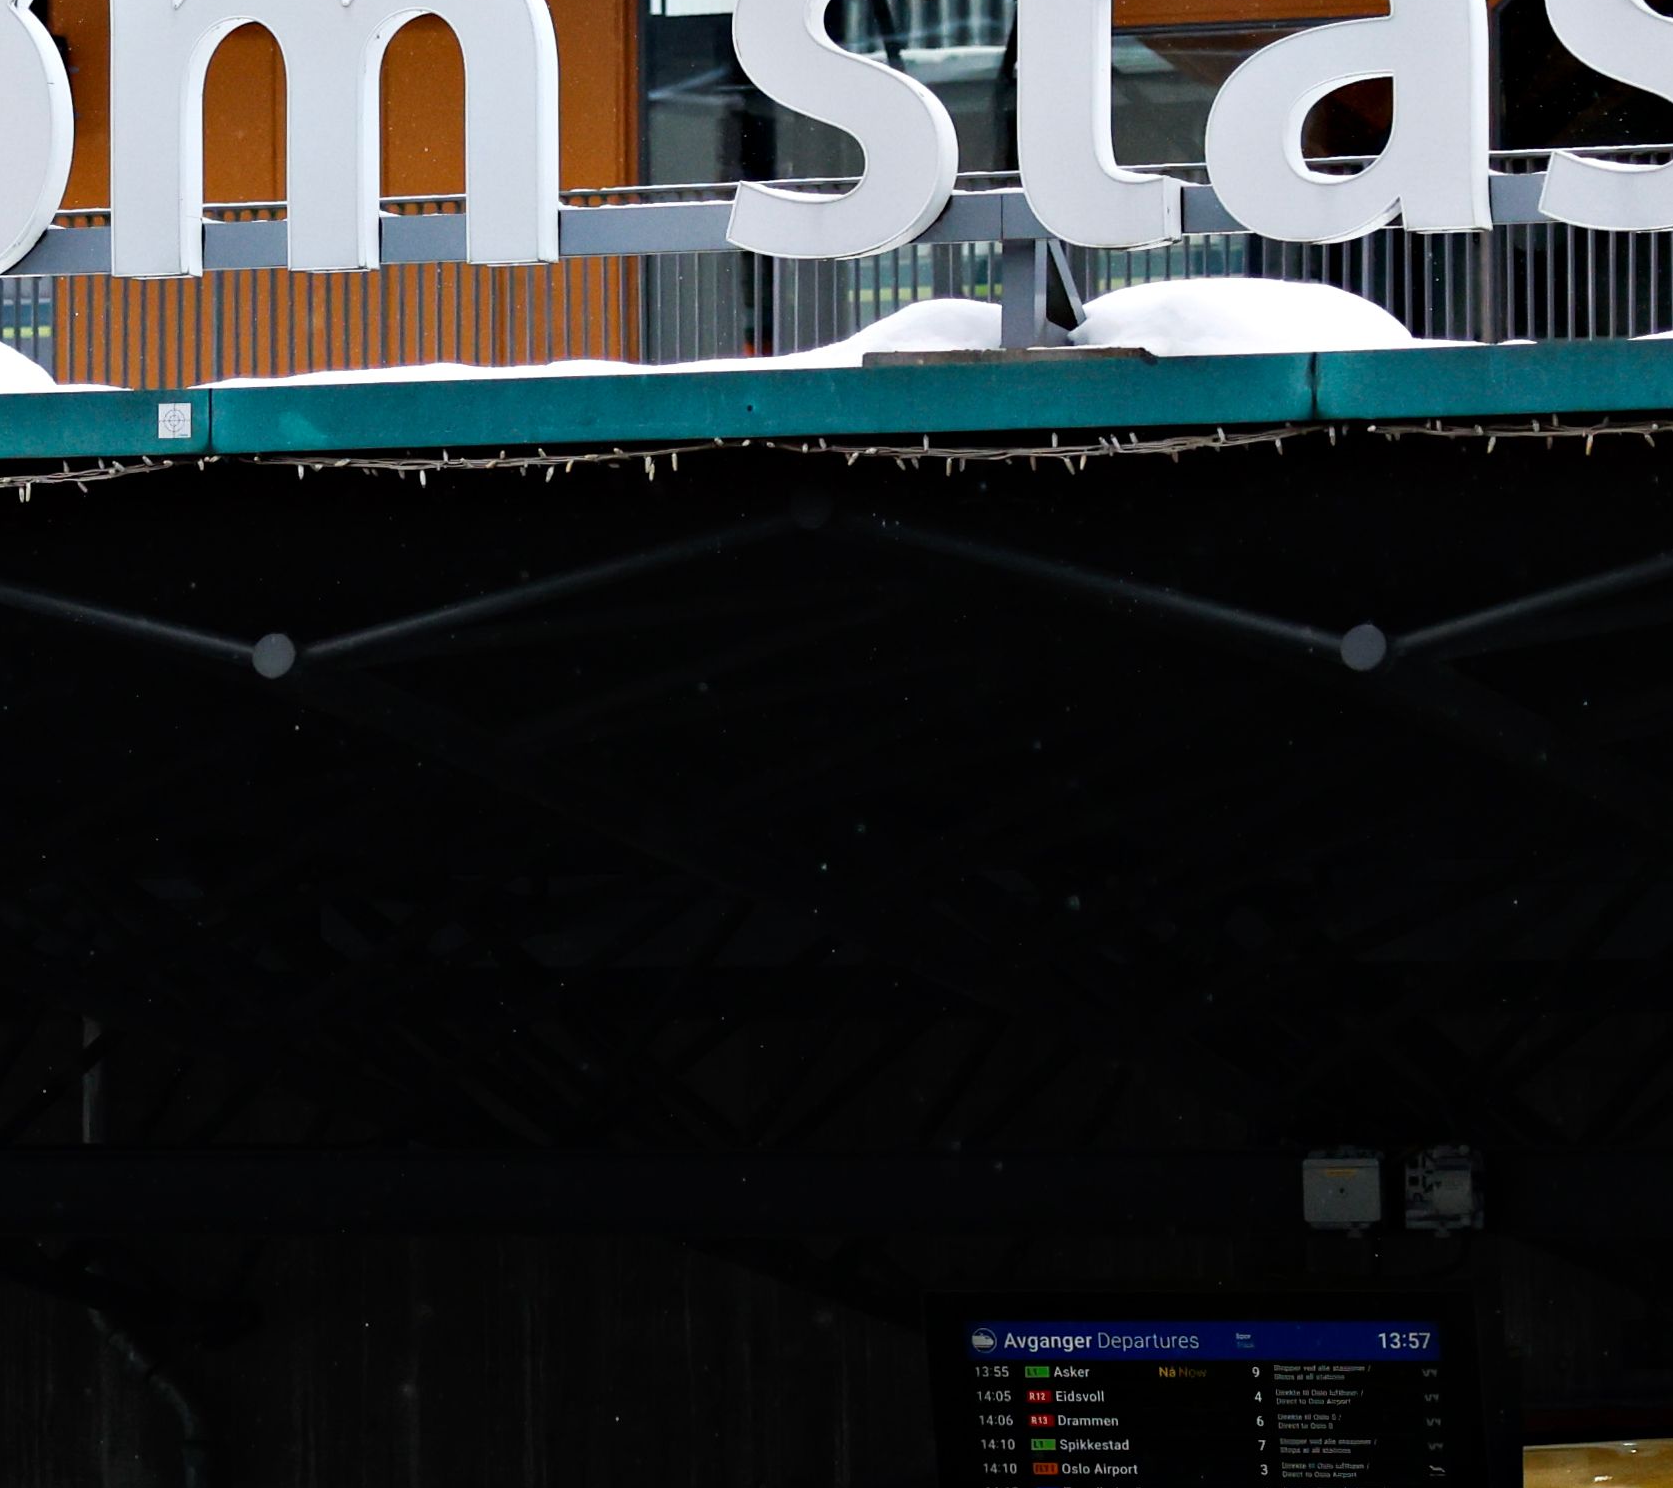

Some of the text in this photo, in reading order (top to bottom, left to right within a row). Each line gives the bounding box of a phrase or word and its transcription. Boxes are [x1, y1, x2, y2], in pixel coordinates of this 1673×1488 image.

[1004, 1332, 1093, 1353] Avganger
[1097, 1332, 1200, 1352] Departures
[1378, 1332, 1431, 1349] 13:57
[975, 1365, 1010, 1378] 13:55
[1053, 1366, 1090, 1378] Asker
[1158, 1366, 1176, 1378] Nå
[1251, 1366, 1260, 1378] 9
[977, 1390, 1012, 1402] 14:05
[1029, 1392, 1046, 1401] R12
[1055, 1390, 1105, 1402] Eidsvoll
[1254, 1391, 1262, 1402] 4
[979, 1414, 1014, 1426] 14:06
[1031, 1416, 1048, 1425] R13
[1057, 1414, 1119, 1427] Drammen
[1256, 1415, 1265, 1427] 6
[981, 1438, 1016, 1451] 14:10
[1059, 1438, 1130, 1453] Spikkestad
[1258, 1439, 1266, 1451] 7
[983, 1463, 1018, 1475] 14:10
[1061, 1462, 1091, 1475] Oslo
[1094, 1463, 1138, 1477] Airport
[1260, 1463, 1269, 1476] 3
